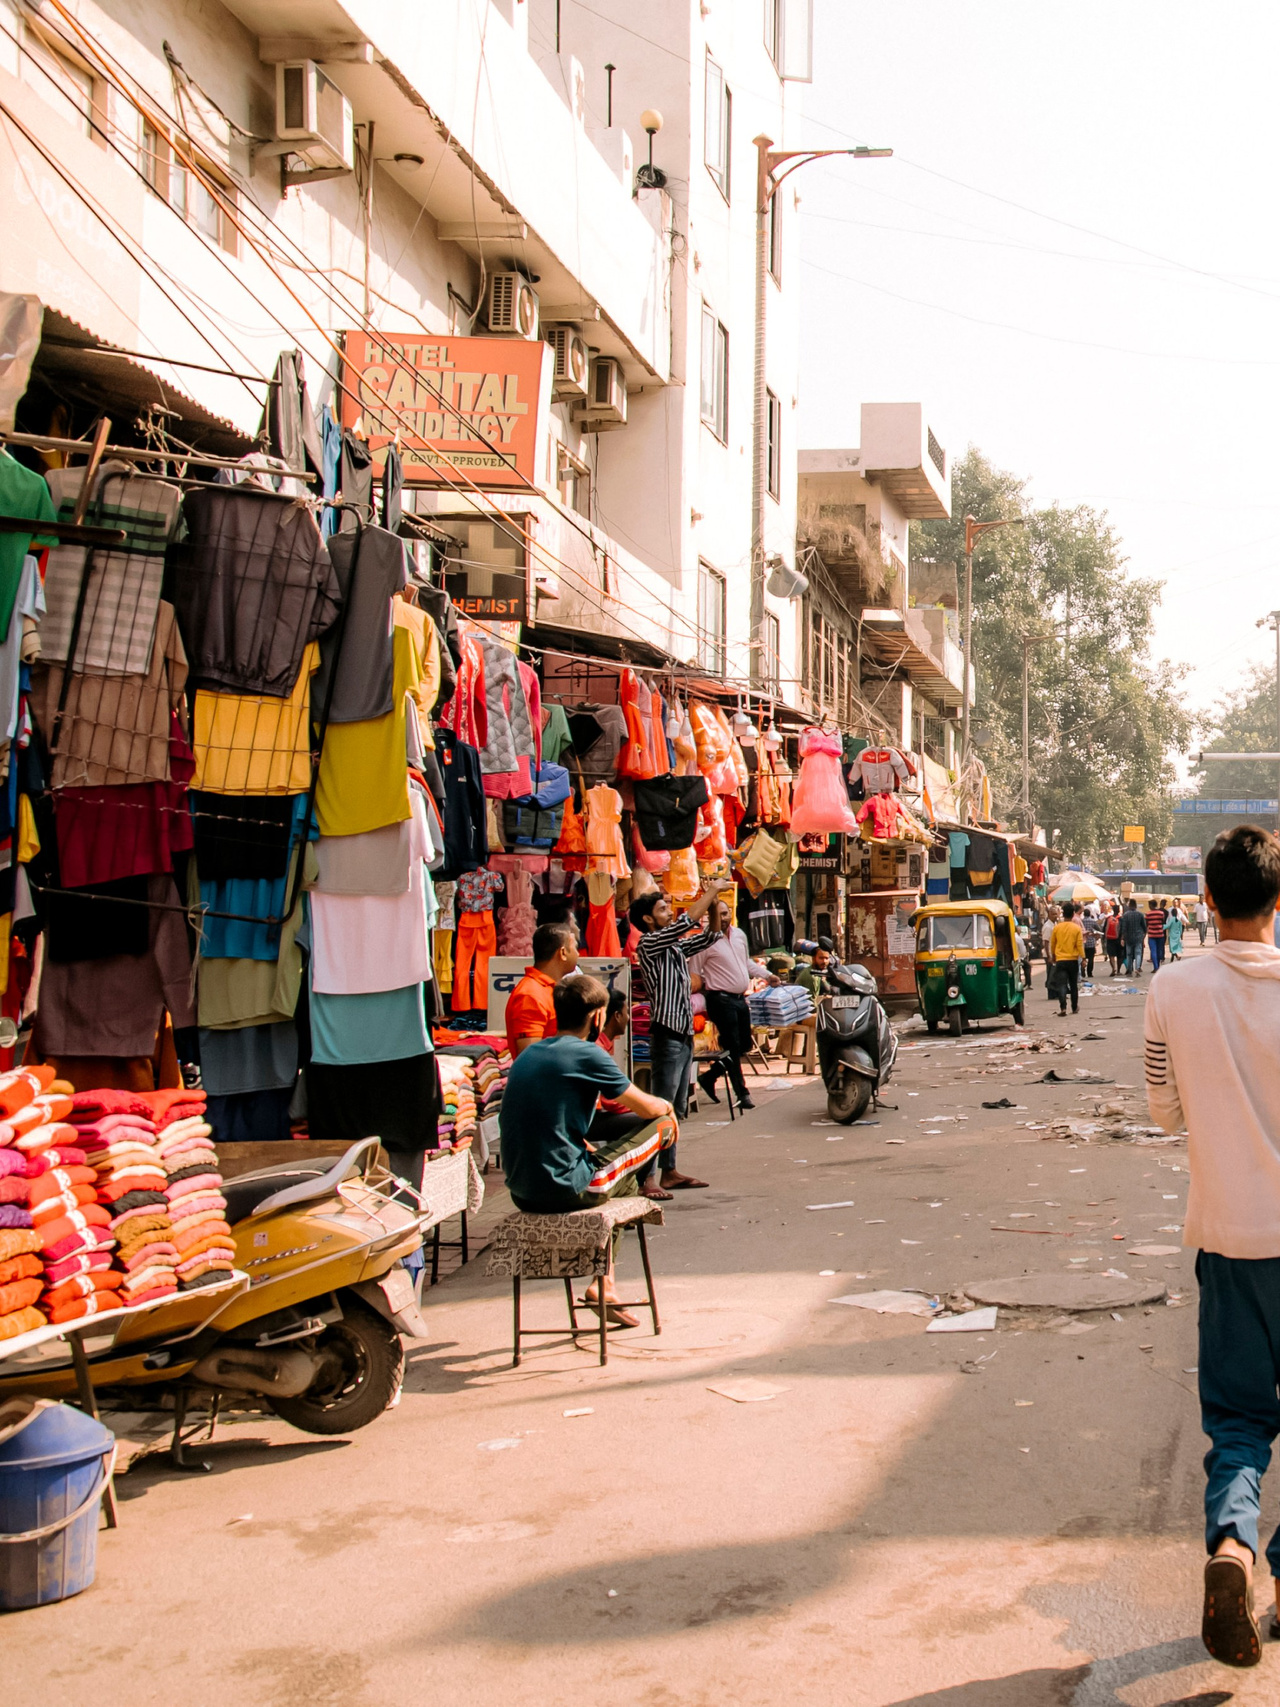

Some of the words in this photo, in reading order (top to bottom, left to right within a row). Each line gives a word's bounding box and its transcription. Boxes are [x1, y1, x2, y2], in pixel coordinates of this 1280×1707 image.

[364, 341, 456, 368] HOTEL
[358, 366, 529, 415] CAPITAL
[362, 409, 519, 444] RESIDENCY
